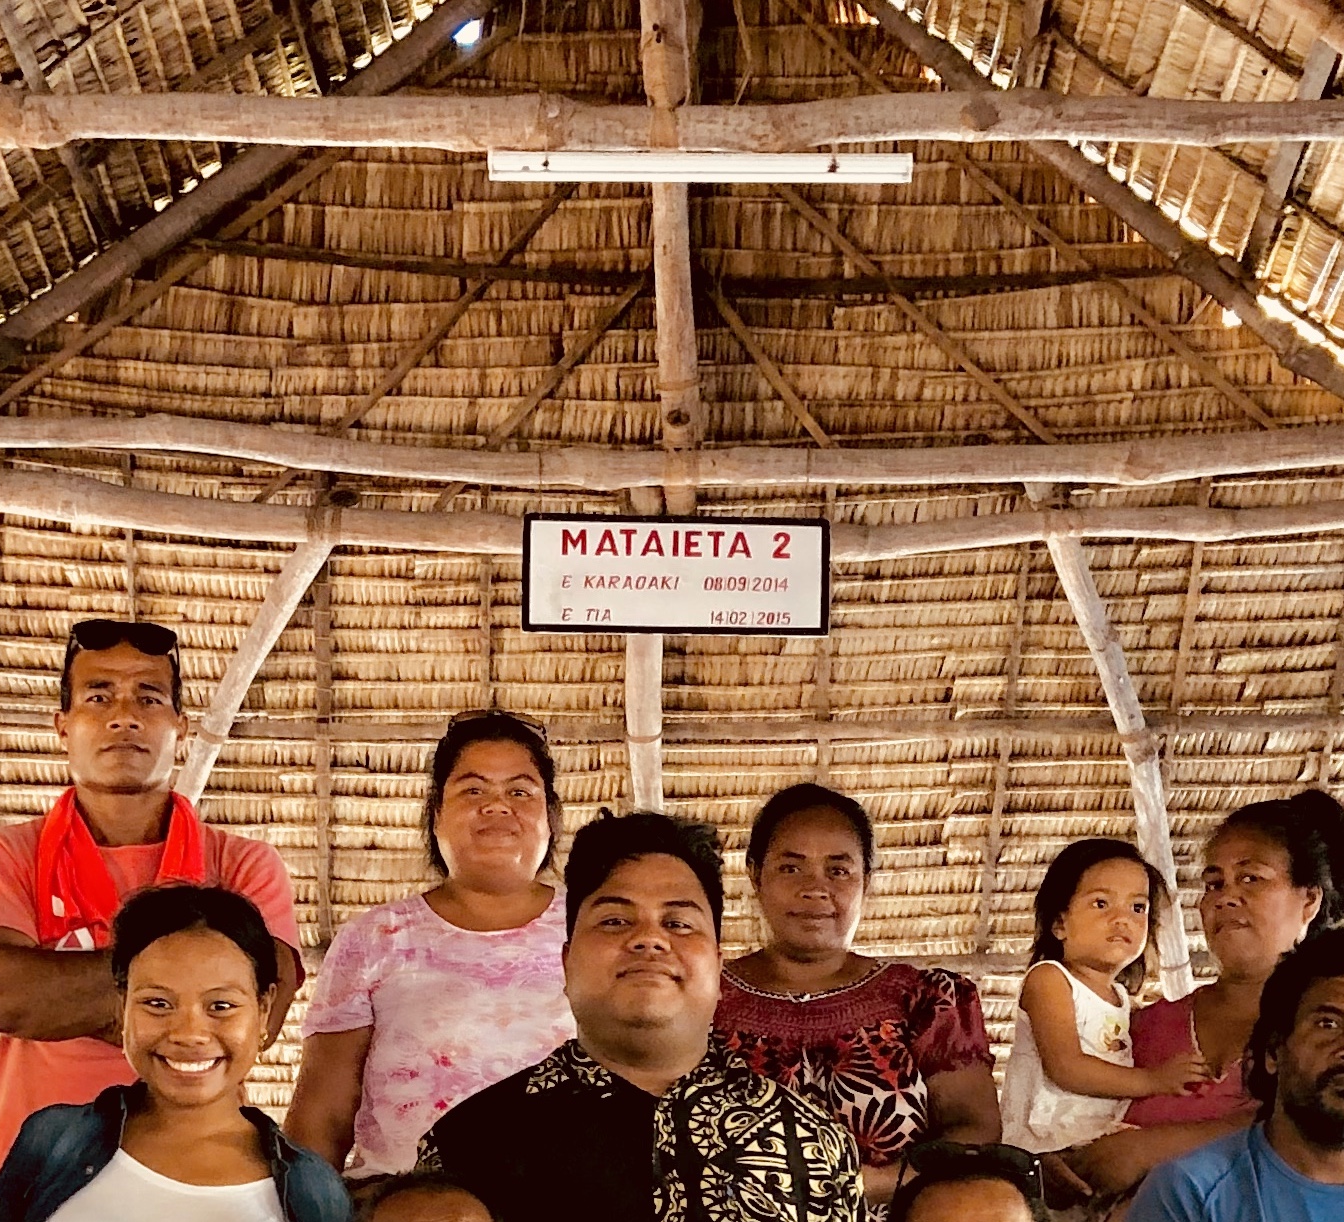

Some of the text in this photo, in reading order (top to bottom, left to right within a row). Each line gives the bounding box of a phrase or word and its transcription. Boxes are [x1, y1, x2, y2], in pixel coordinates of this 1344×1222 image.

[560, 528, 792, 559] MATAIETA 2
[561, 575, 573, 589] E
[583, 575, 681, 591] KARAOAKI
[561, 607, 574, 622] E
[585, 608, 612, 622] TIA
